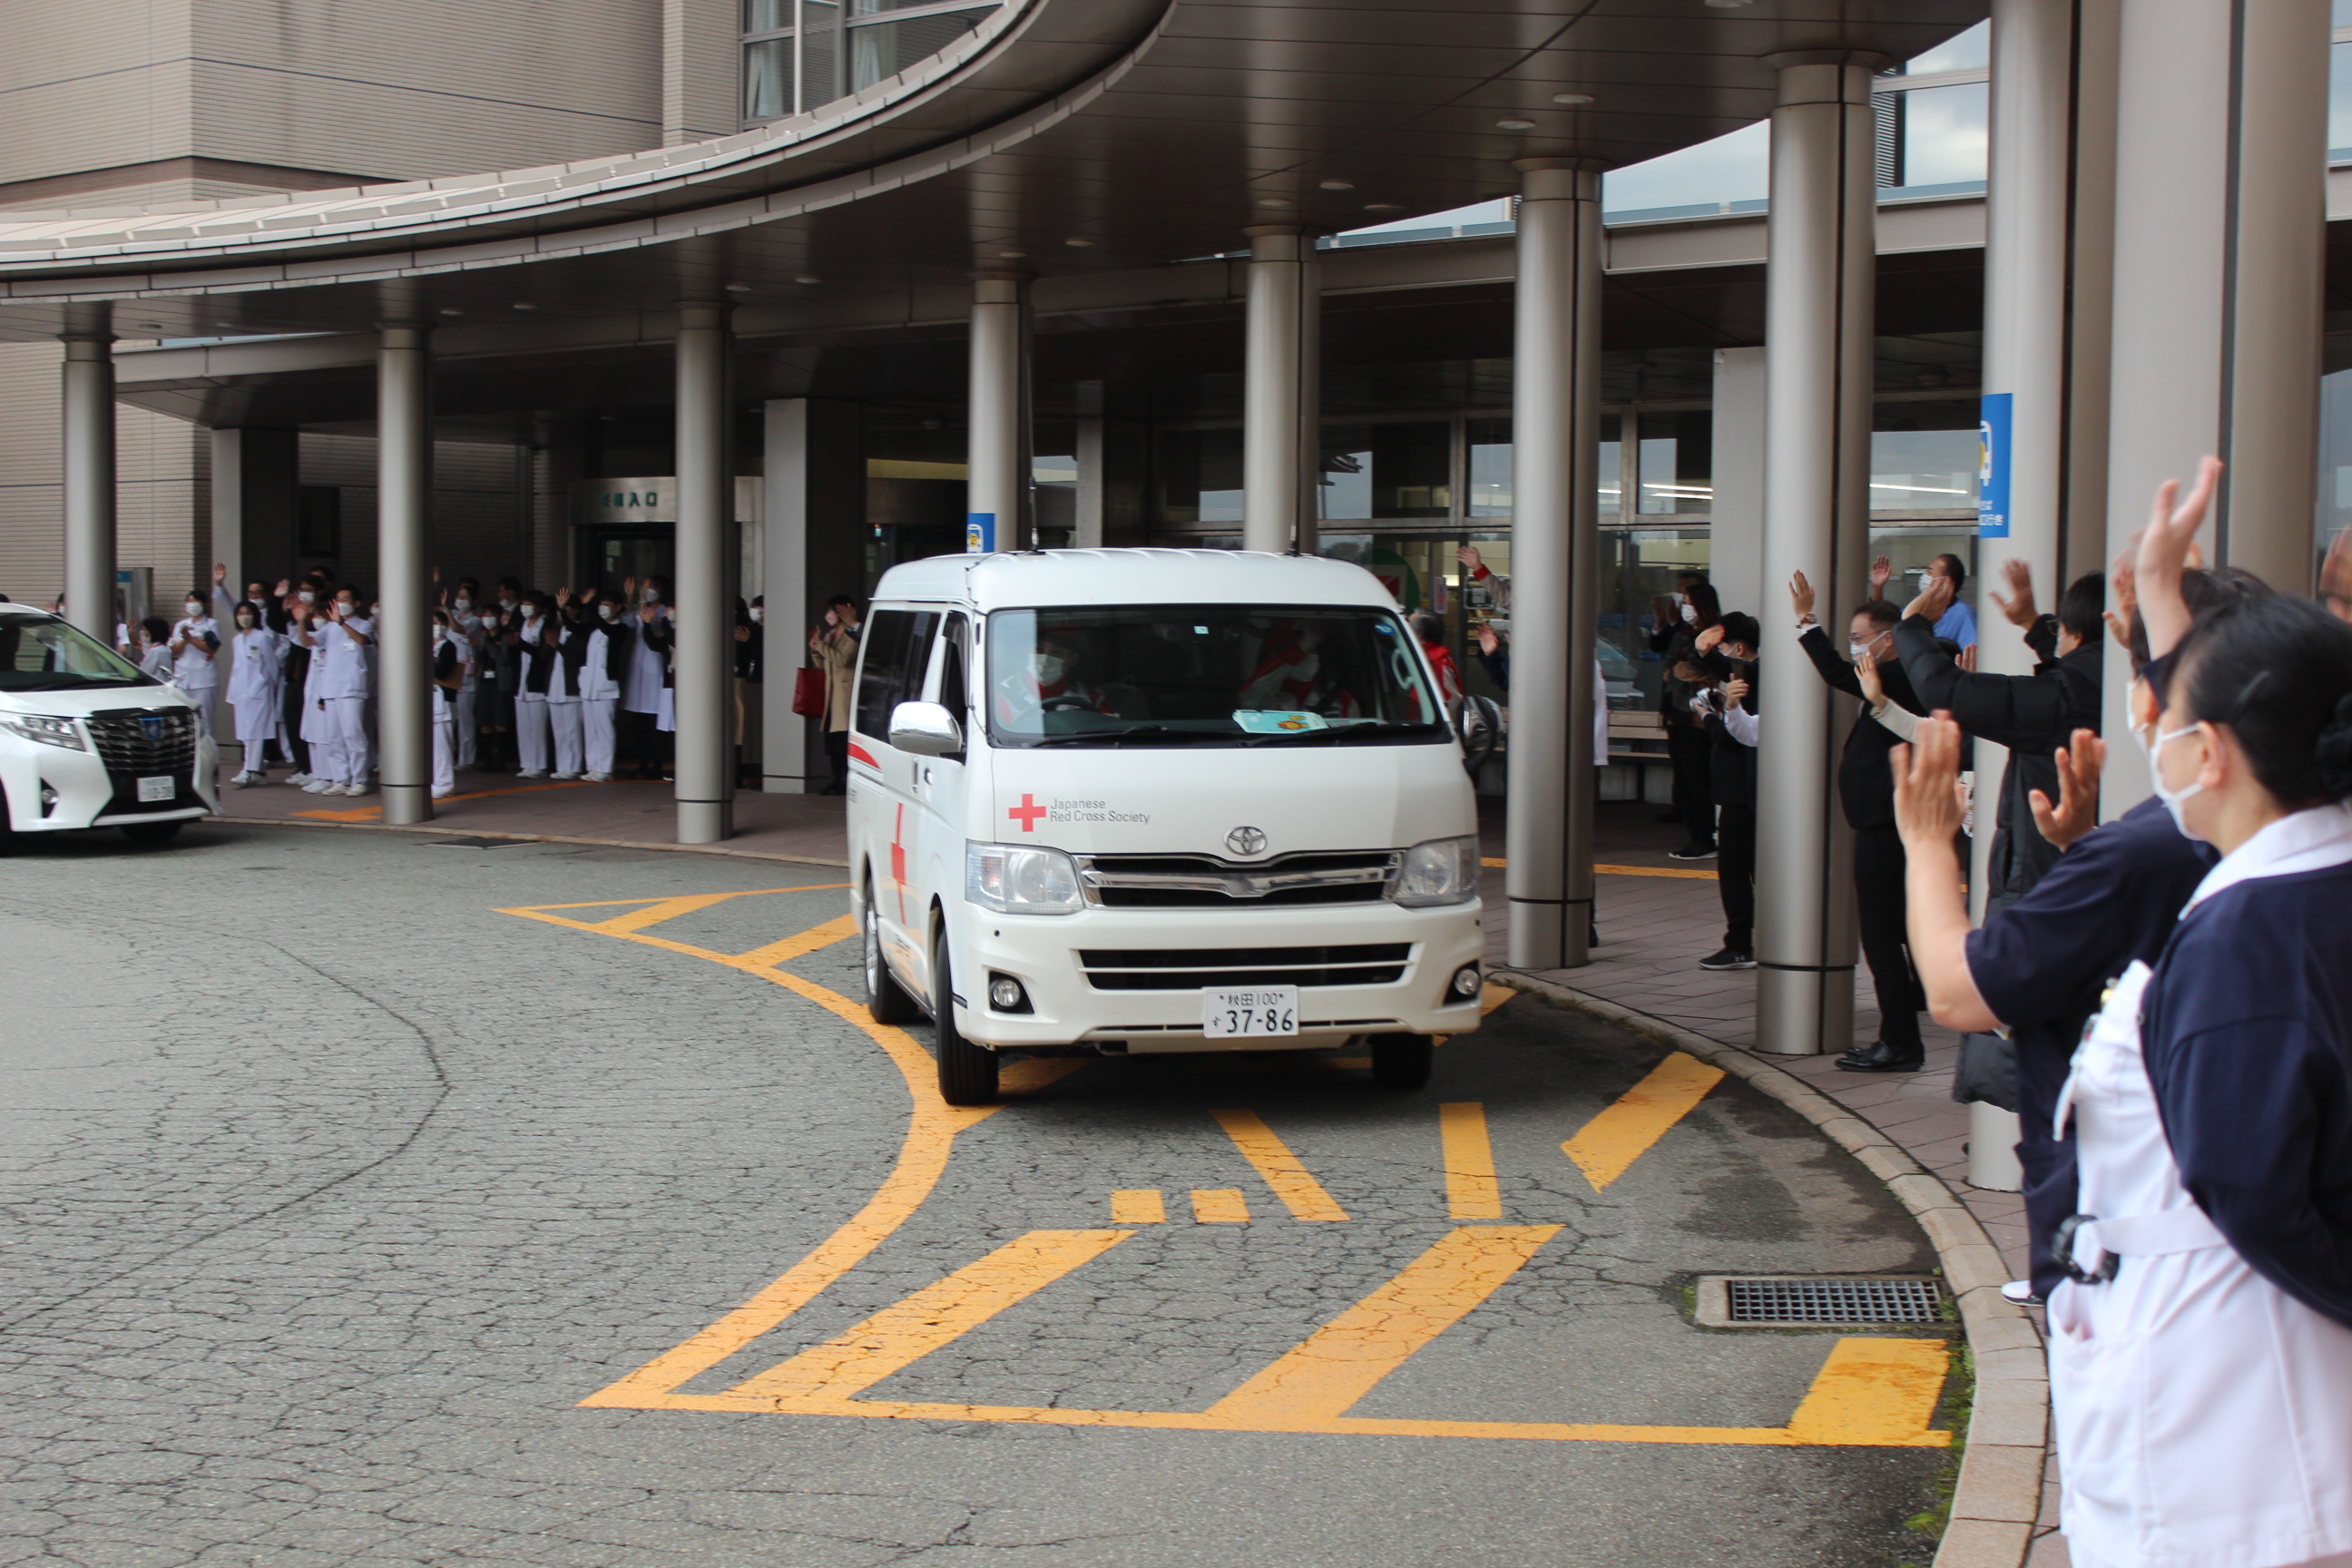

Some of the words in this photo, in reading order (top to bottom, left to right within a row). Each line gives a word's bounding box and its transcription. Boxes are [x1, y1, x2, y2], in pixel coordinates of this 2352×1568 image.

[1051, 799, 1106, 811] Japanese
[1051, 810, 1072, 823] Red
[1074, 810, 1105, 822] Cross
[1108, 810, 1151, 825] Society
[1226, 1008, 1293, 1033] 37-86
